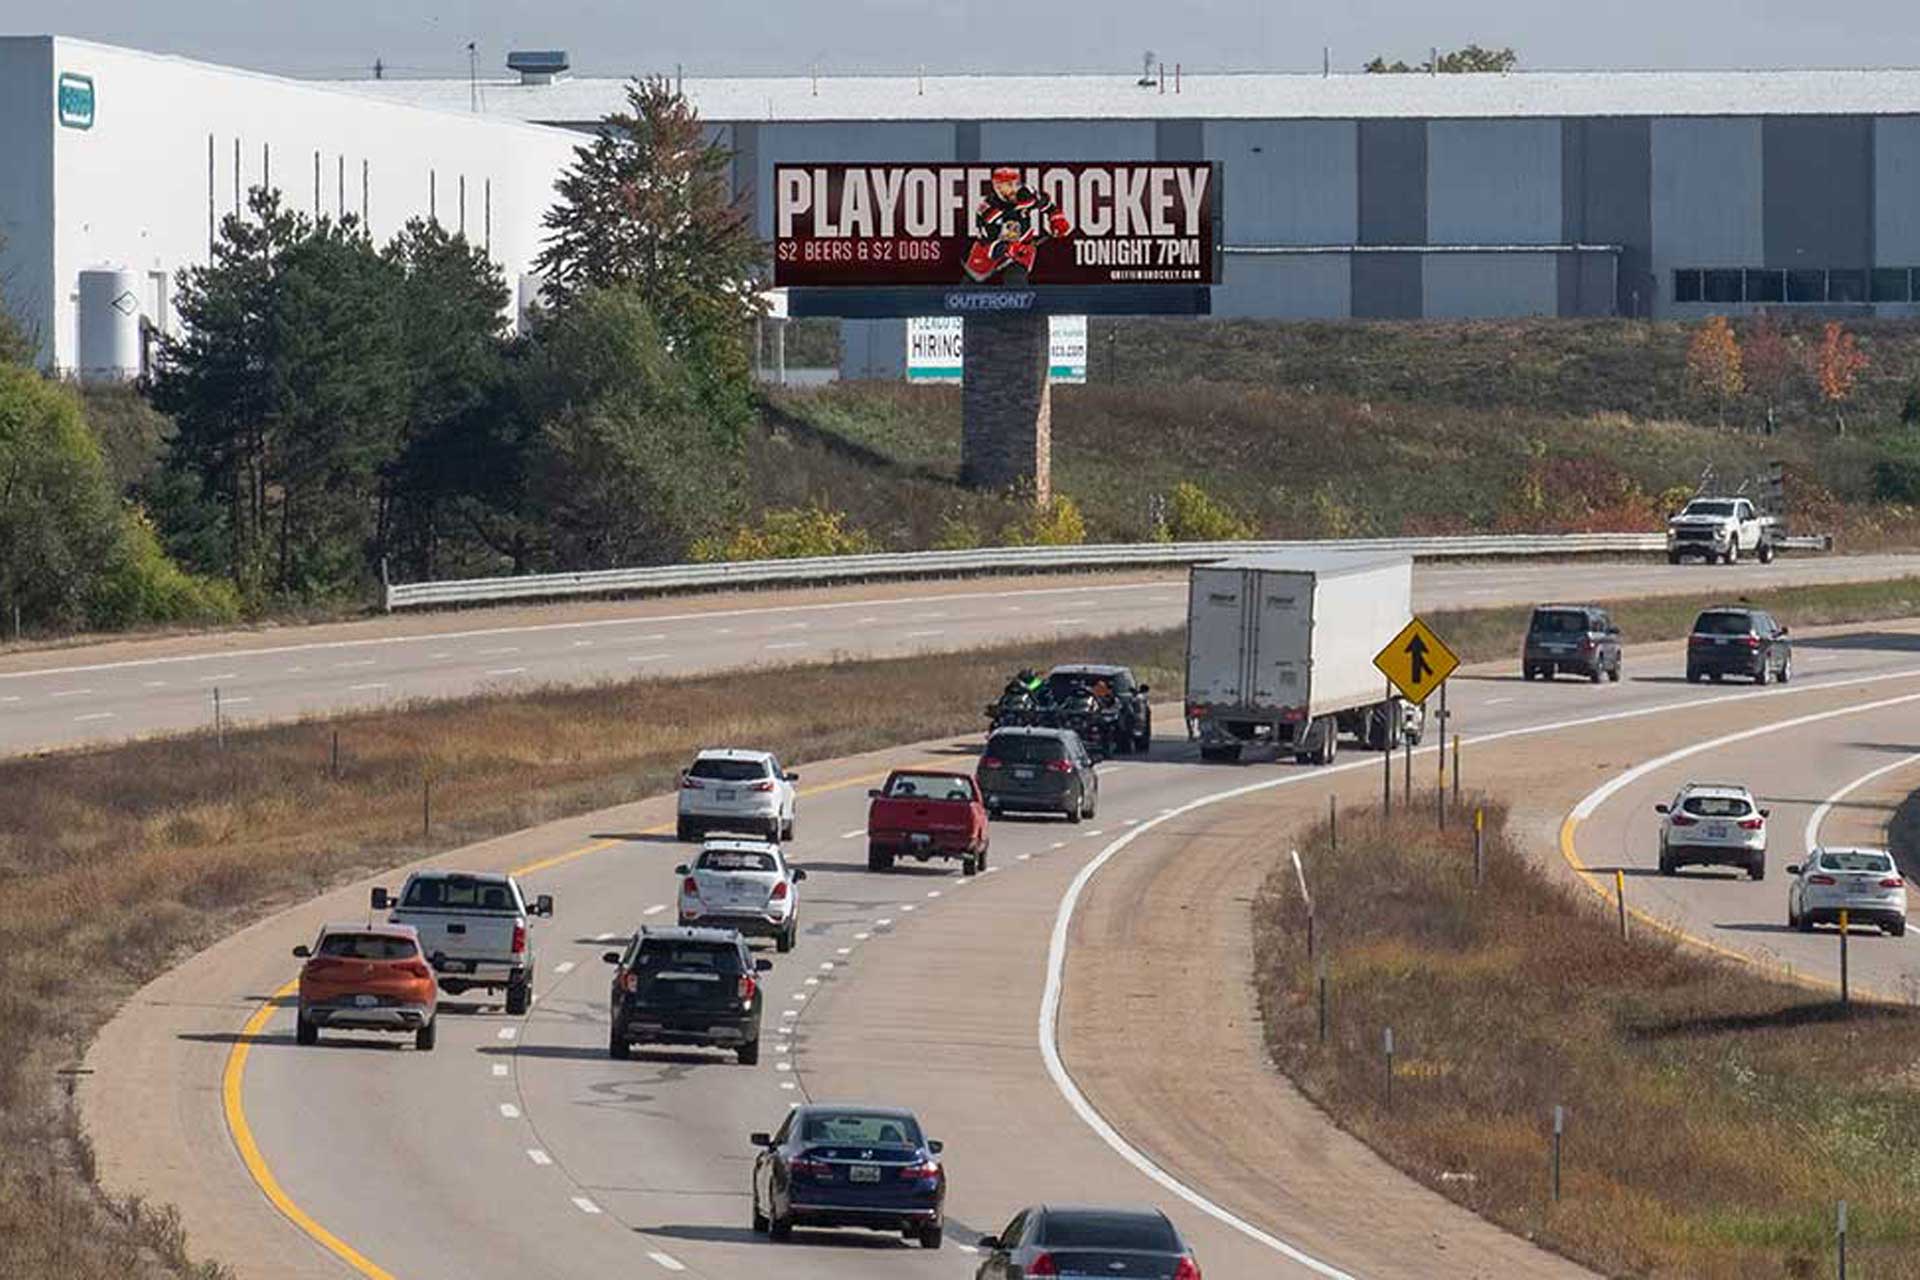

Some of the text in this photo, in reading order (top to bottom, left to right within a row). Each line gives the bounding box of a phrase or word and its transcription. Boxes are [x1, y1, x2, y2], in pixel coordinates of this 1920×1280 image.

[778, 168, 993, 238] PLAYOFF
[804, 241, 852, 262] BEERS
[857, 241, 869, 261] &
[899, 241, 942, 261] DOGS
[1073, 239, 1200, 266] TONIGHT 7PM
[911, 333, 961, 359] HIRING
